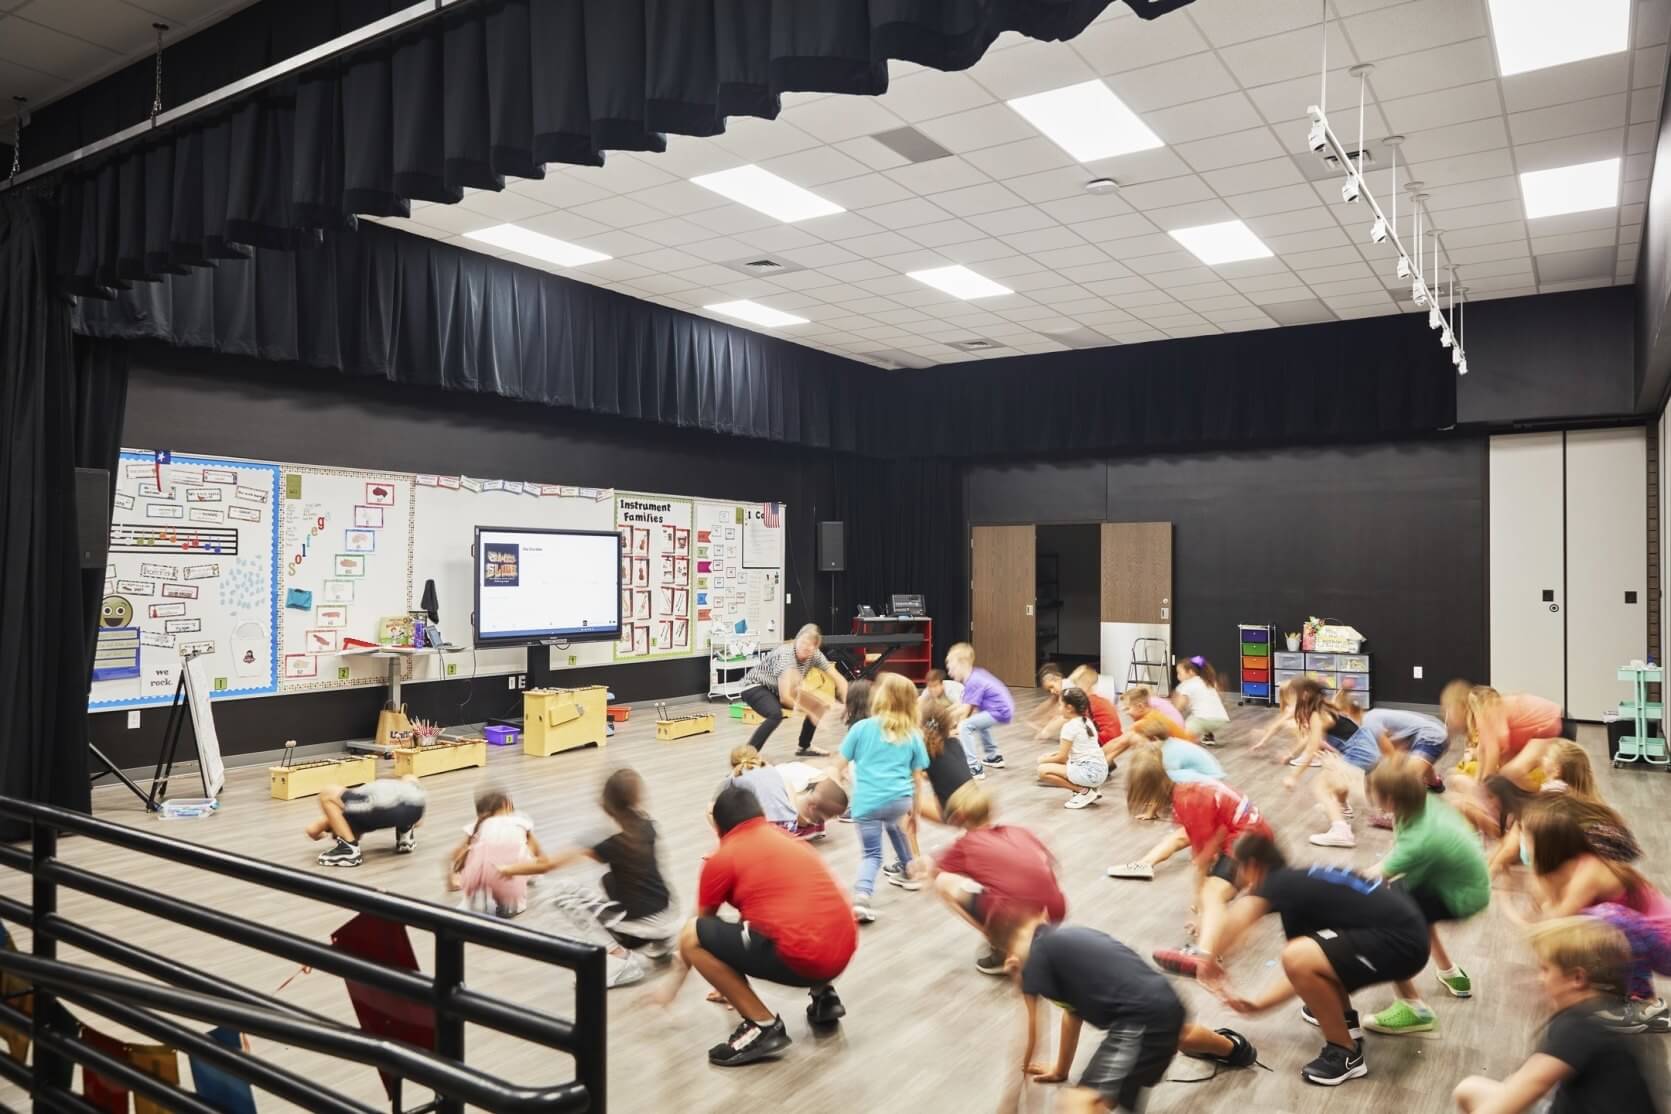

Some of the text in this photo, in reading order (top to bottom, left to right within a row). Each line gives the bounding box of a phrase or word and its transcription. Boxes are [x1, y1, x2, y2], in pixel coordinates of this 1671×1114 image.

[620, 499, 671, 512] Instrument
[624, 512, 664, 523] Families
[150, 678, 173, 687] rock.
